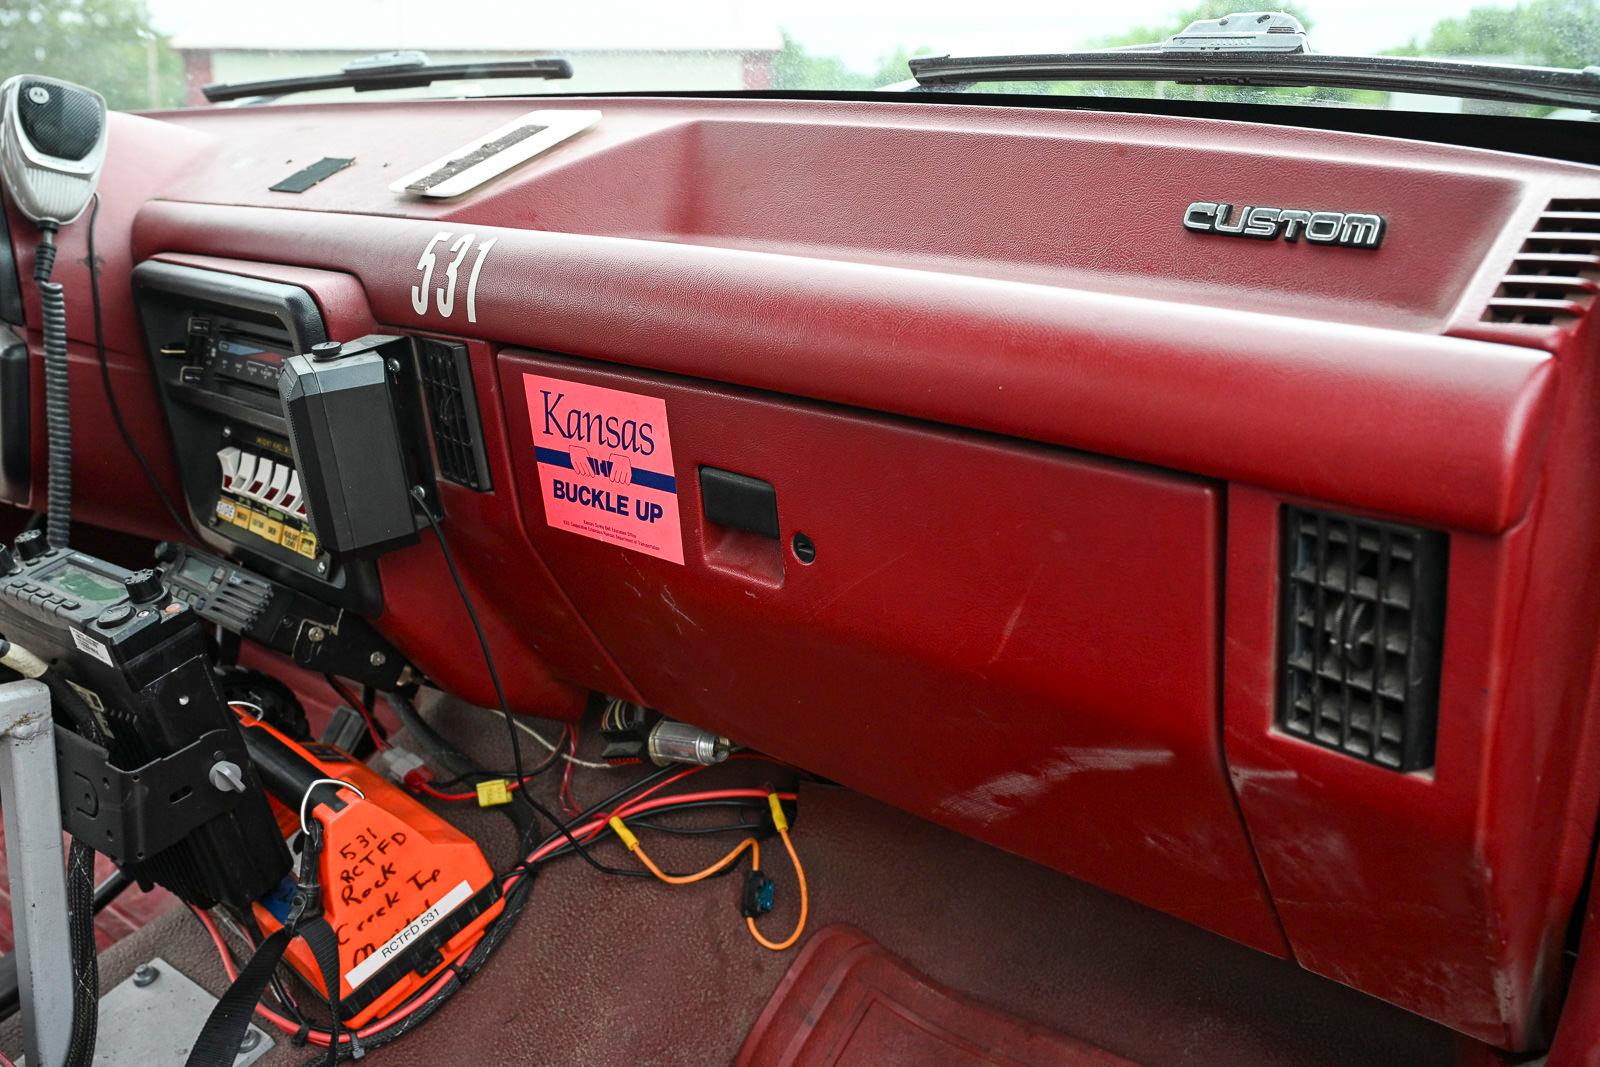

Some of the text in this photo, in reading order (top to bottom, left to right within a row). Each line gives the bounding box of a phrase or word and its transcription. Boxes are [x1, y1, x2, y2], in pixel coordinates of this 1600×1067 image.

[1183, 200, 1387, 250] CUSTOM
[411, 231, 498, 323] 531
[540, 390, 655, 456] Kansas
[553, 479, 664, 524] BUCKLE UP
[339, 827, 378, 861] 531
[340, 832, 407, 884] RCTFD
[341, 862, 398, 906] Rock
[381, 908, 441, 958] RCTFD 531
